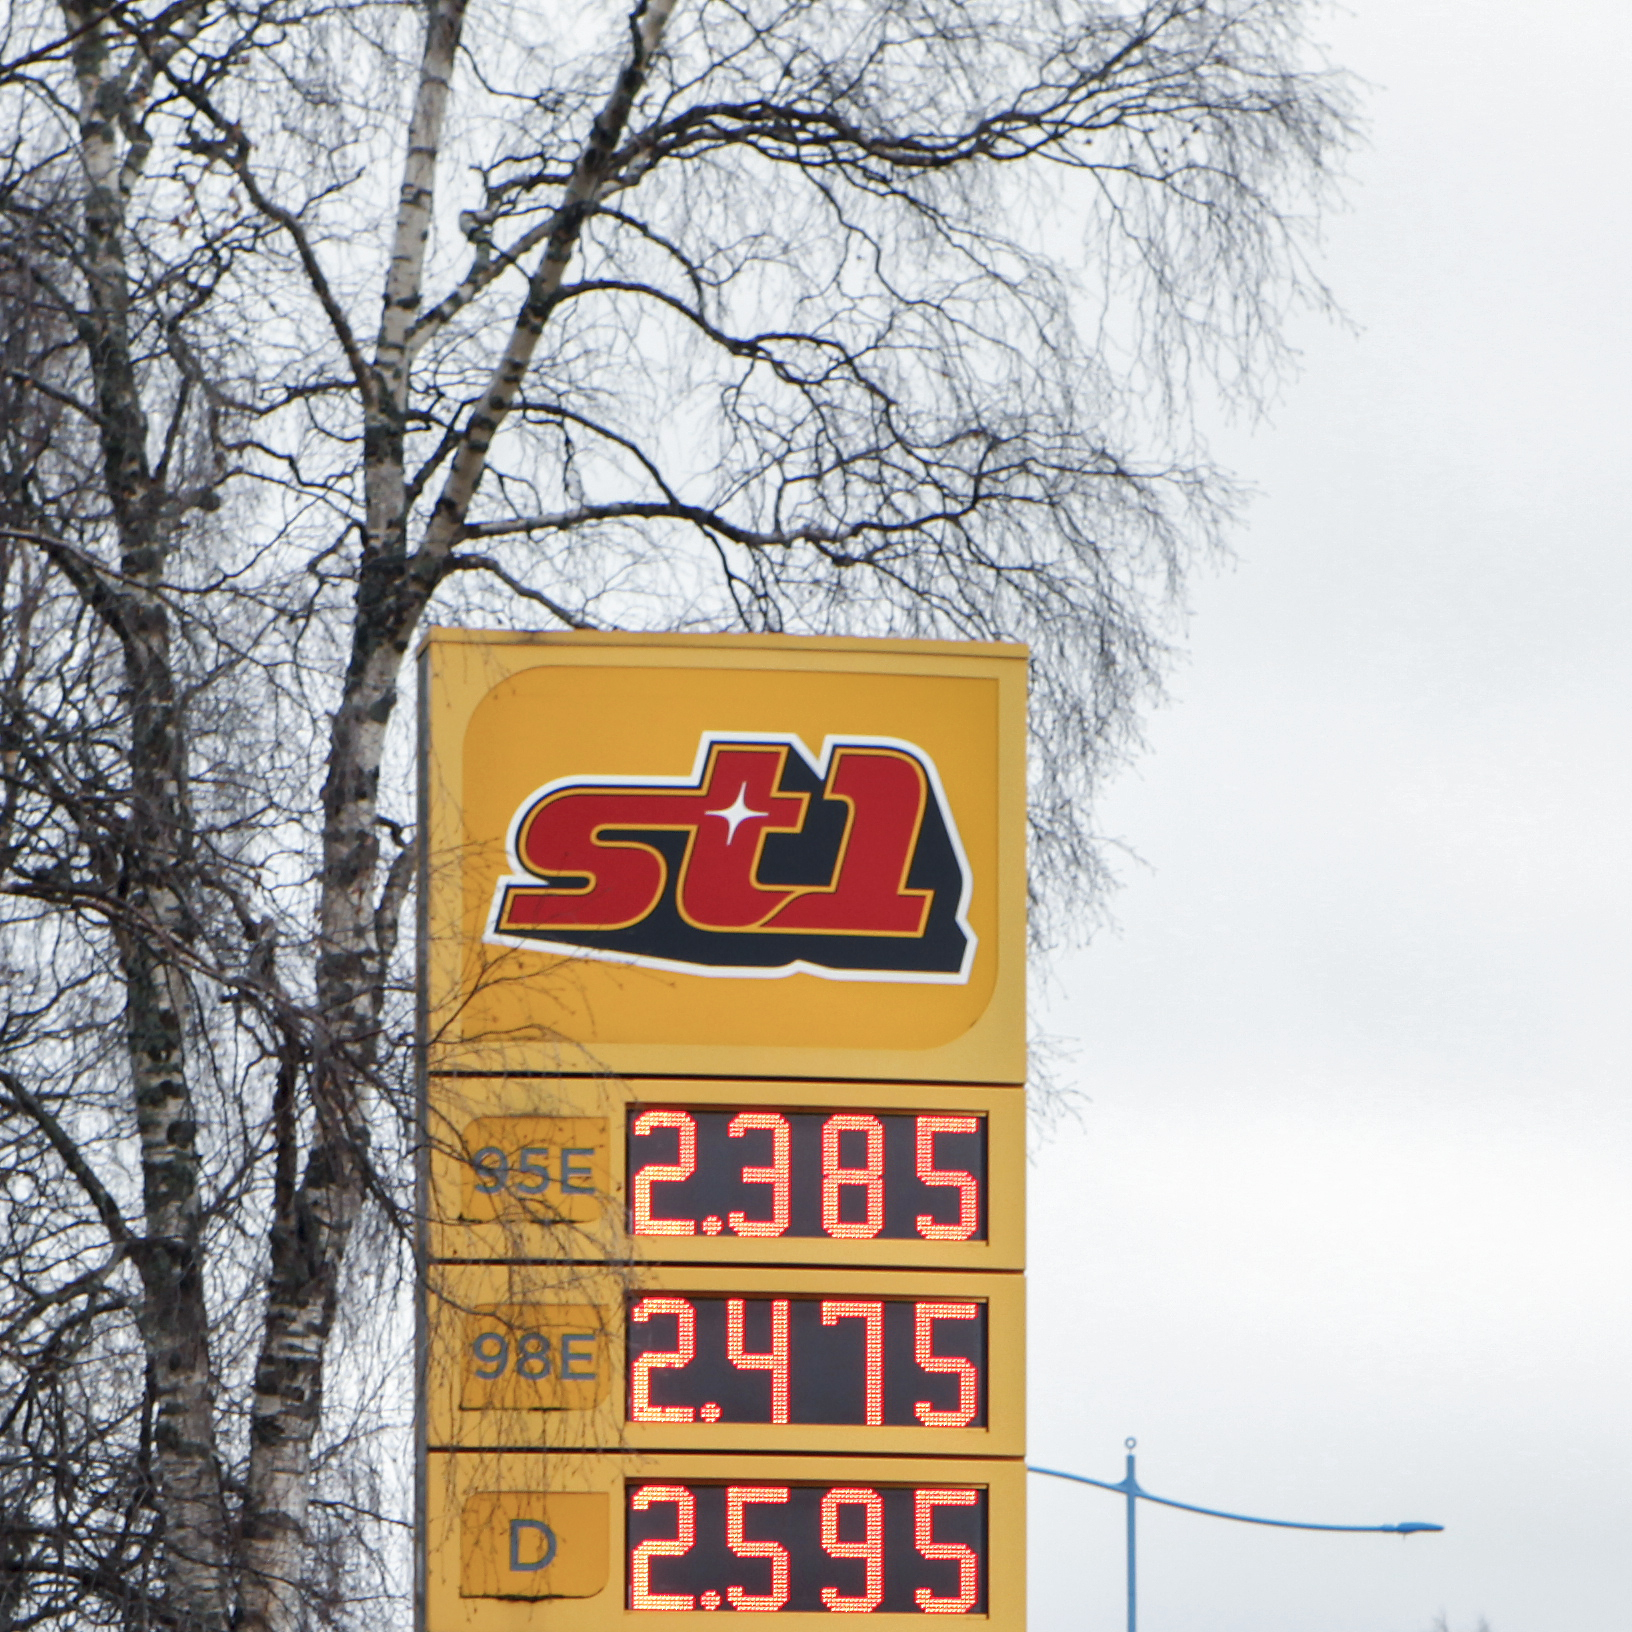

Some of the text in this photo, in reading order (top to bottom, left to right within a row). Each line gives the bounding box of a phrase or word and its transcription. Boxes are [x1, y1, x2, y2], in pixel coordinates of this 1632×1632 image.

[473, 1146, 596, 1195] 95E
[632, 1109, 980, 1241] 2.385
[472, 1332, 597, 1382] 98E
[632, 1296, 979, 1428] 2.475
[508, 1518, 558, 1573] D
[632, 1484, 979, 1614] 2.595
